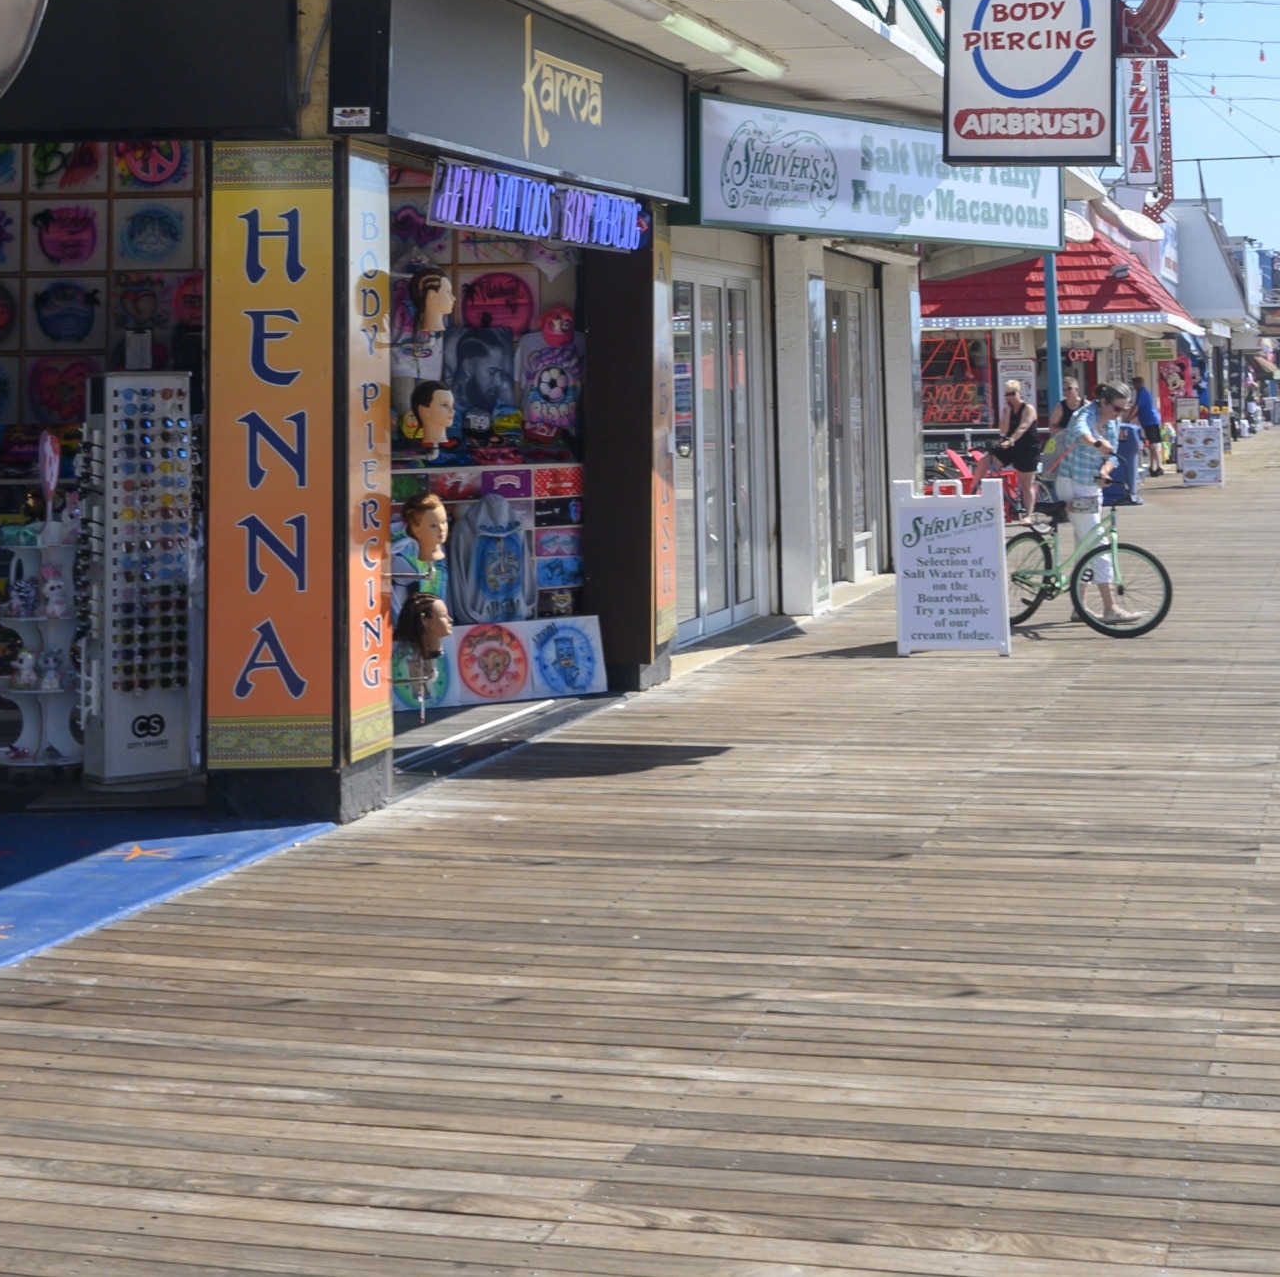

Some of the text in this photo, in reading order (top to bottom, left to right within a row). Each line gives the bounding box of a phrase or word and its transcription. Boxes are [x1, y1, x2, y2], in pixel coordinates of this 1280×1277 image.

[992, 1, 1066, 22] BODY
[963, 30, 1096, 51] PIERCING
[522, 13, 603, 160] karma
[959, 112, 1100, 136] AIRBRUSH
[1128, 58, 1153, 173] IZZA
[731, 137, 821, 187] SHRIVER'S
[861, 134, 910, 176] Salt
[934, 188, 1049, 230] Macaroons
[1001, 331, 1020, 346] ATM
[1068, 348, 1095, 363] OPEN
[234, 207, 308, 700] HENNA
[358, 210, 382, 689] BODY PIERCING
[901, 507, 995, 548] SHRIVER'S
[927, 545, 972, 556] Largest
[916, 556, 984, 567] Selection of
[902, 568, 997, 580] Salt Water Taffy
[932, 581, 969, 591] on the
[917, 593, 985, 603] Boardwalk.
[914, 606, 934, 618] Try
[948, 605, 990, 618] sample
[934, 618, 970, 627] of our
[911, 630, 994, 641] creamy fudge.
[132, 715, 164, 738] CS
